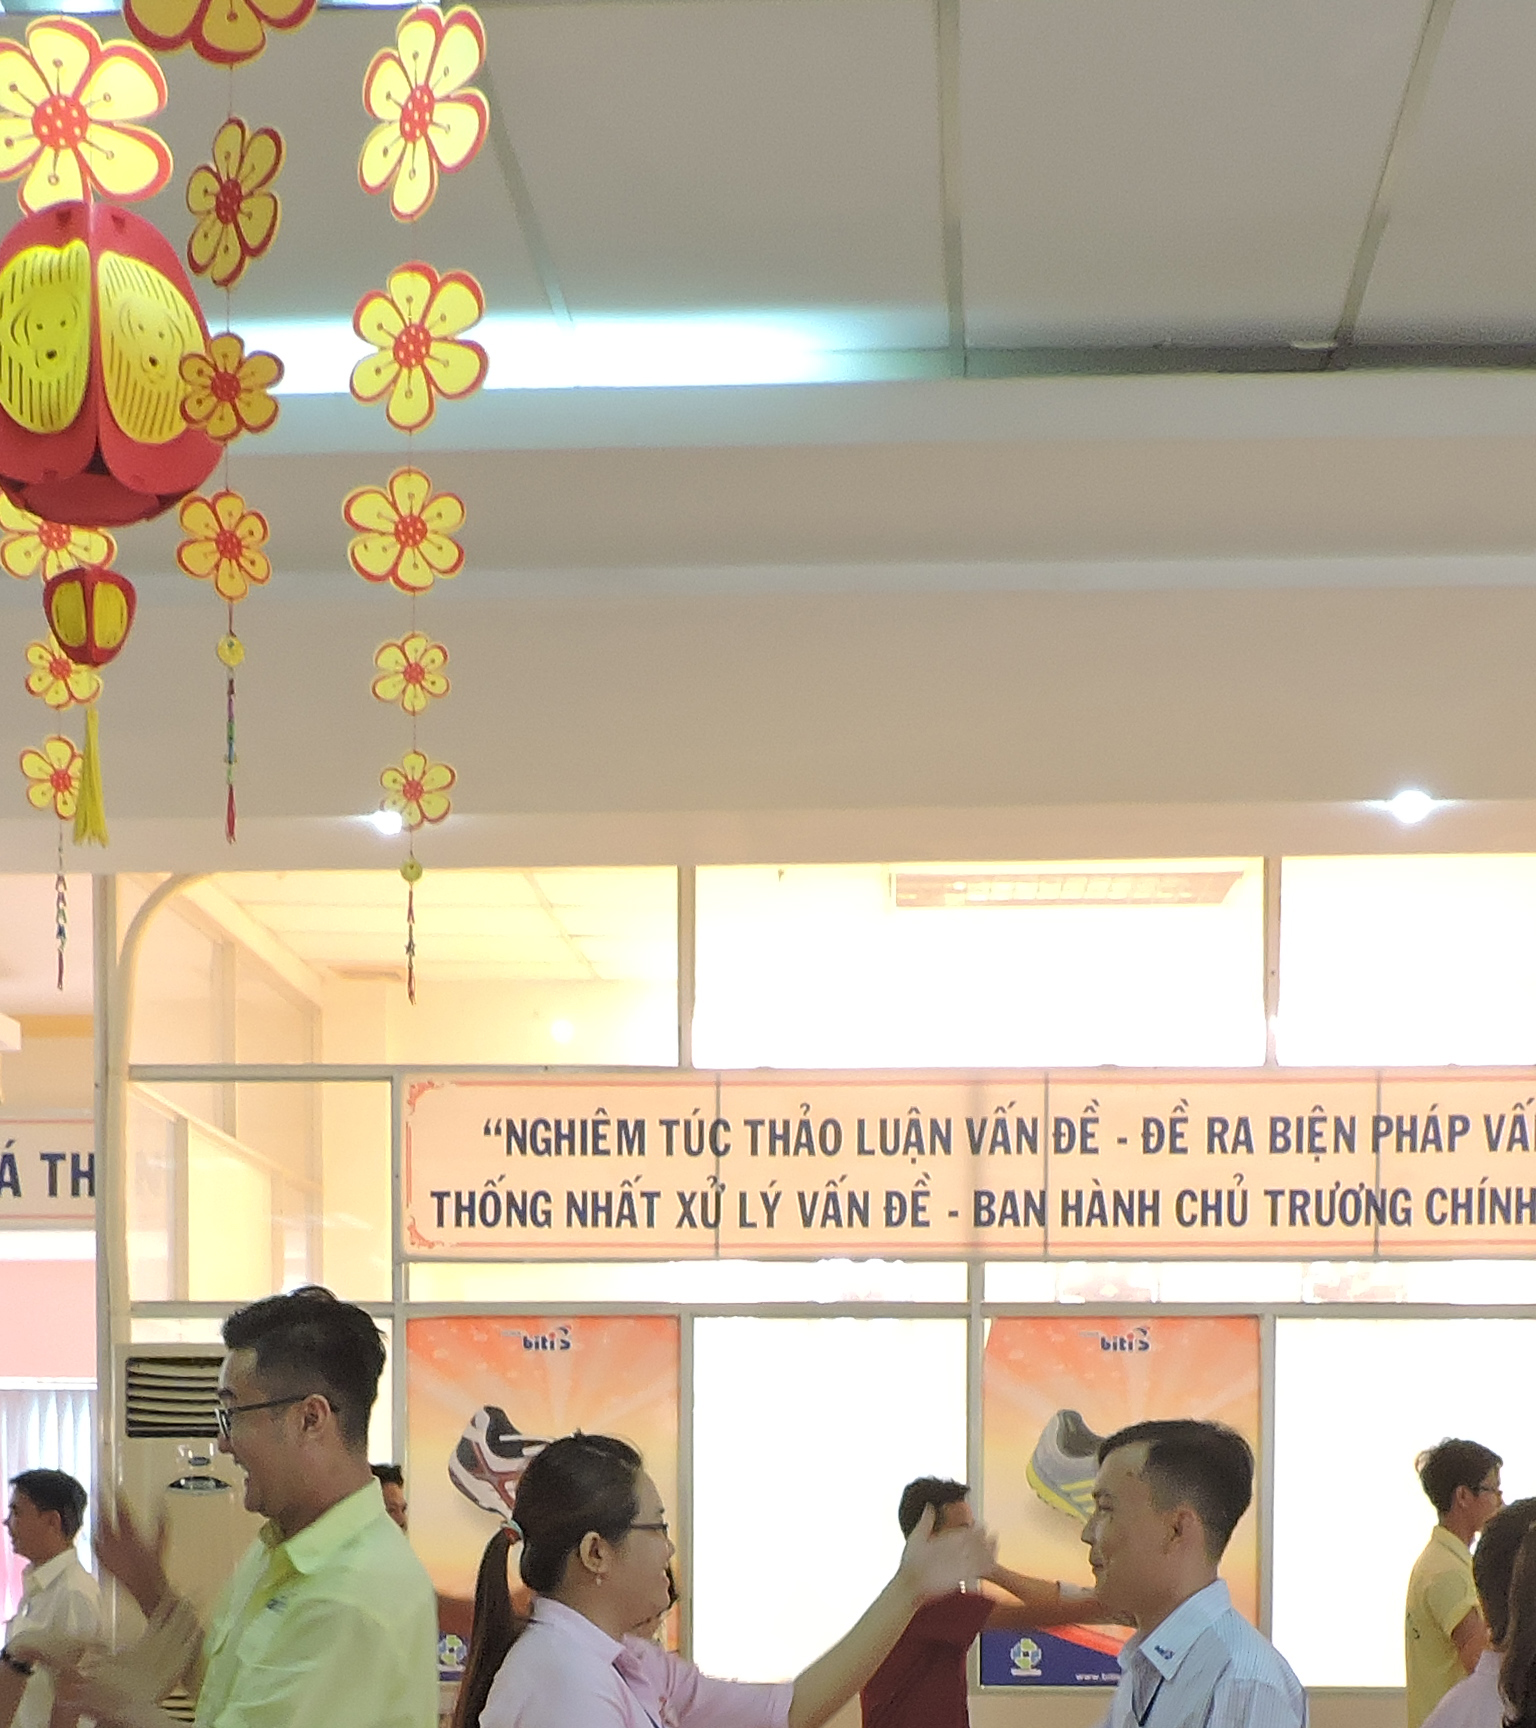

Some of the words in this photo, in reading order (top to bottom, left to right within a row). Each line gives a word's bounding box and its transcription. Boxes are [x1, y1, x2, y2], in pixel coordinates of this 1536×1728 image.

[658, 1108, 731, 1157] TÚC
[744, 1103, 842, 1157] THẢO
[857, 1106, 952, 1164] LUẬN
[965, 1101, 1038, 1156] VẤN
[1052, 1099, 1099, 1155] ĐỀ
[1141, 1098, 1189, 1155] ĐỀ
[1207, 1116, 1254, 1154] RA
[1269, 1105, 1356, 1162] BIỆN
[1371, 1103, 1471, 1154] PHÁP
[431, 1174, 552, 1228] THỐNG
[566, 1175, 661, 1228] NHẤT
[676, 1175, 726, 1228] XỬ
[739, 1180, 782, 1228] LÝ
[797, 1174, 870, 1228] VẤN
[883, 1172, 931, 1228] ĐỀ
[973, 1189, 1046, 1228] BAN
[1061, 1178, 1160, 1228] HÀNH
[1175, 1173, 1248, 1228] CHỦ
[1263, 1181, 1412, 1227] TRƯƠNG
